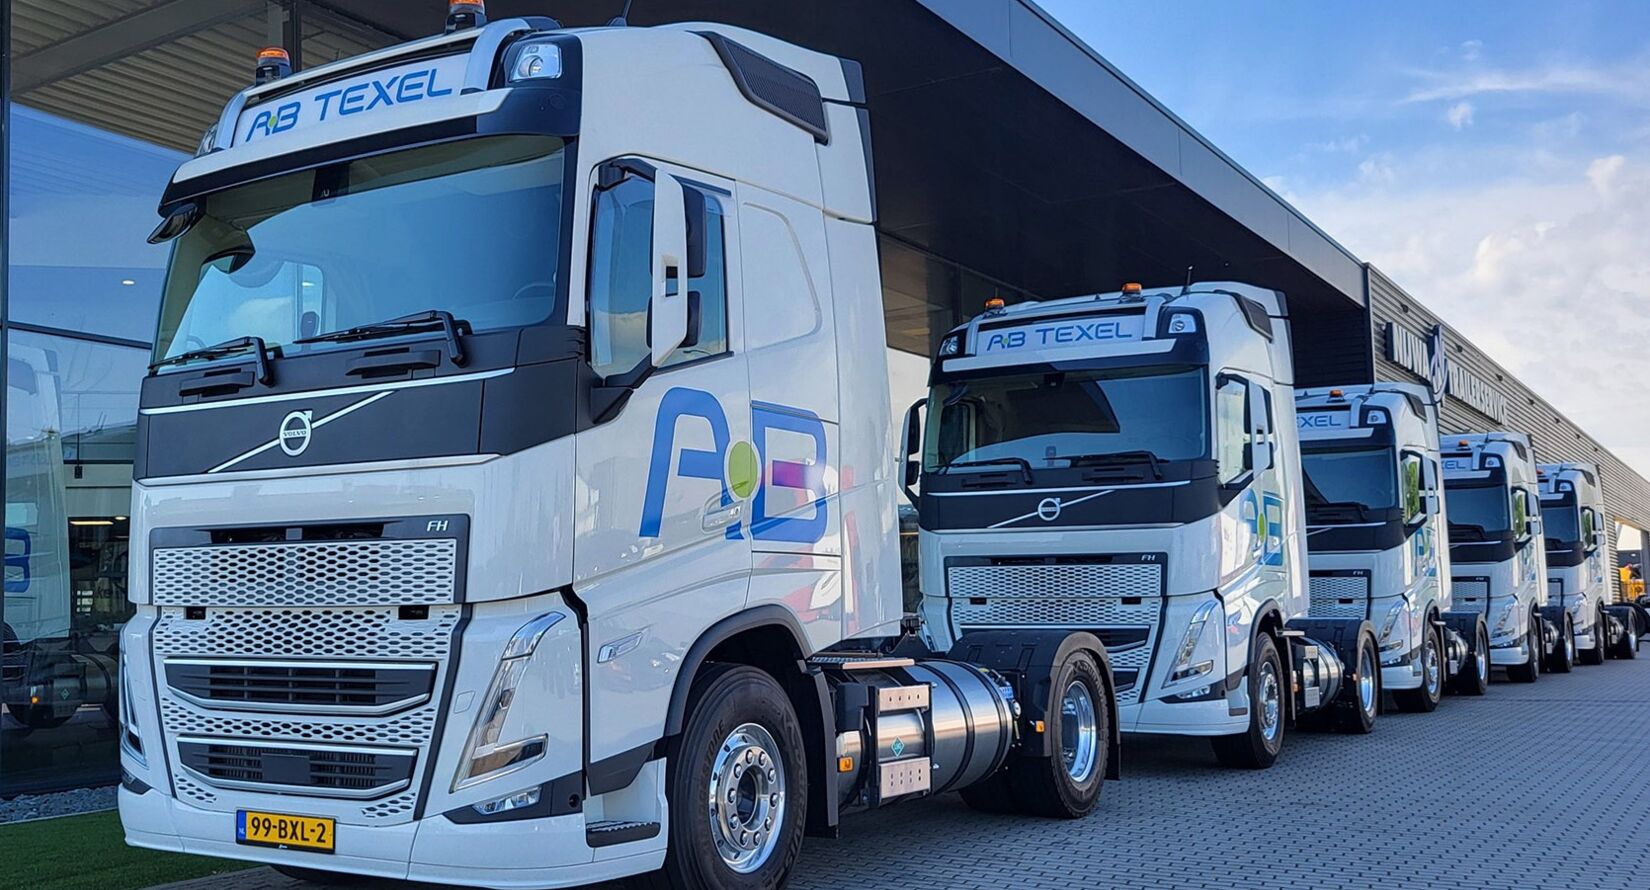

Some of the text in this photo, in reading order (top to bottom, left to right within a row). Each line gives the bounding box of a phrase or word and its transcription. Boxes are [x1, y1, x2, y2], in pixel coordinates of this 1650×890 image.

[314, 68, 453, 121] TEXEL
[1035, 322, 1132, 344] TEXEL
[427, 520, 448, 531] FH
[251, 816, 326, 843] 99-BXL-2
